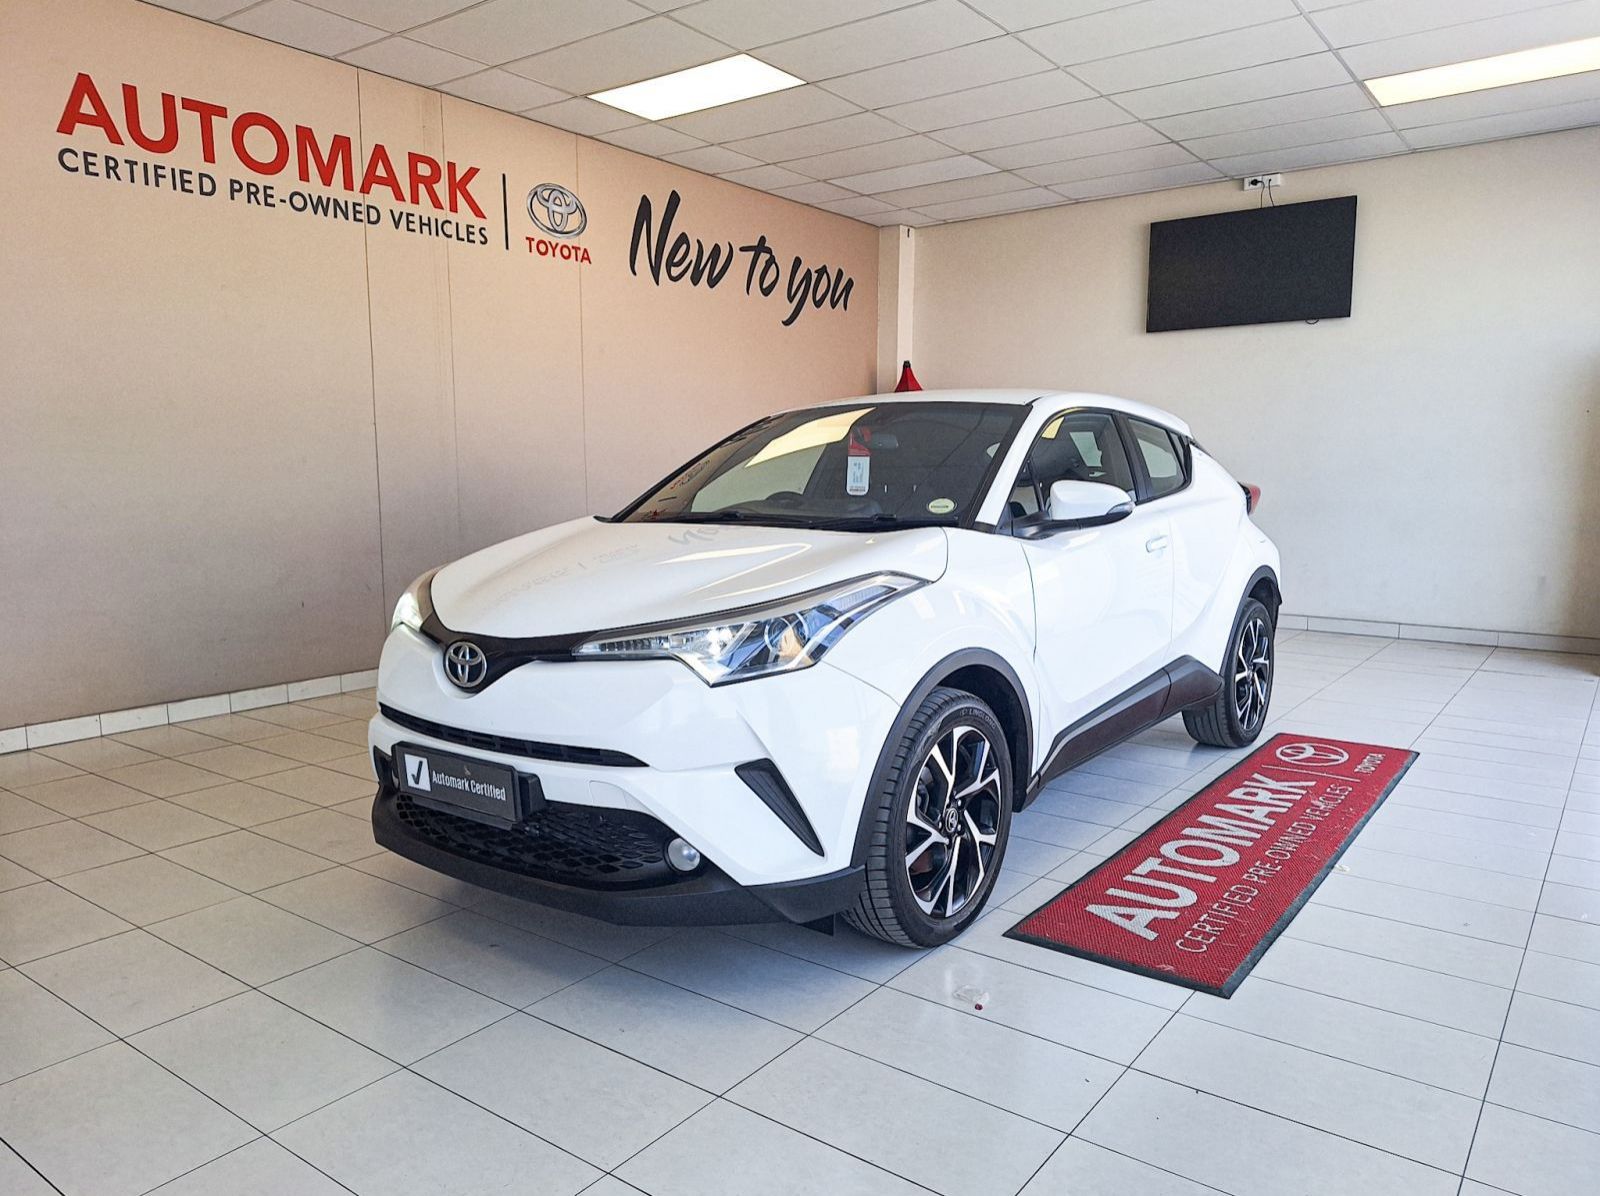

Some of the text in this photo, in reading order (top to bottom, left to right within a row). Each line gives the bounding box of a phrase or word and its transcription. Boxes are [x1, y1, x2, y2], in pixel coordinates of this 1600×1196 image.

[56, 72, 487, 220] AUTOMARK
[57, 147, 488, 245] CERTIFIED PRE-OWNED VEHICLES
[525, 236, 592, 265] TOYOTA
[629, 189, 854, 327] New to you
[432, 769, 506, 801] Automark Certified
[1085, 772, 1317, 941] AUTOMARK
[1176, 783, 1353, 953] CERTIFIED PRE-OWNED VEHICLES
